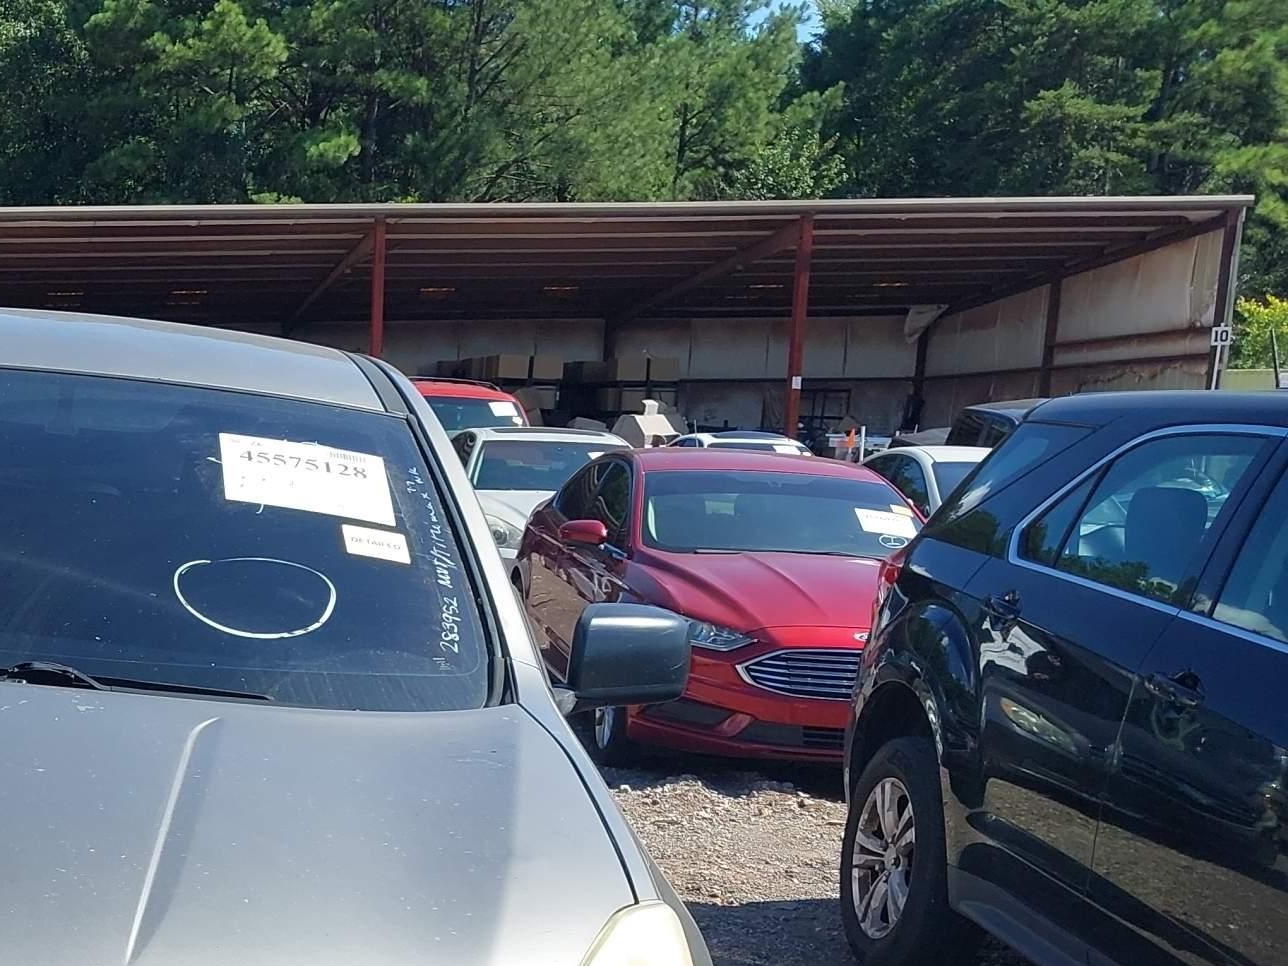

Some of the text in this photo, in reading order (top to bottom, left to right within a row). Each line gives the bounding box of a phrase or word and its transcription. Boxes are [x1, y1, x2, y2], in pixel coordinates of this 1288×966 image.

[1214, 330, 1229, 343] 10
[239, 450, 368, 479] 45575128
[439, 596, 462, 654] 283952
